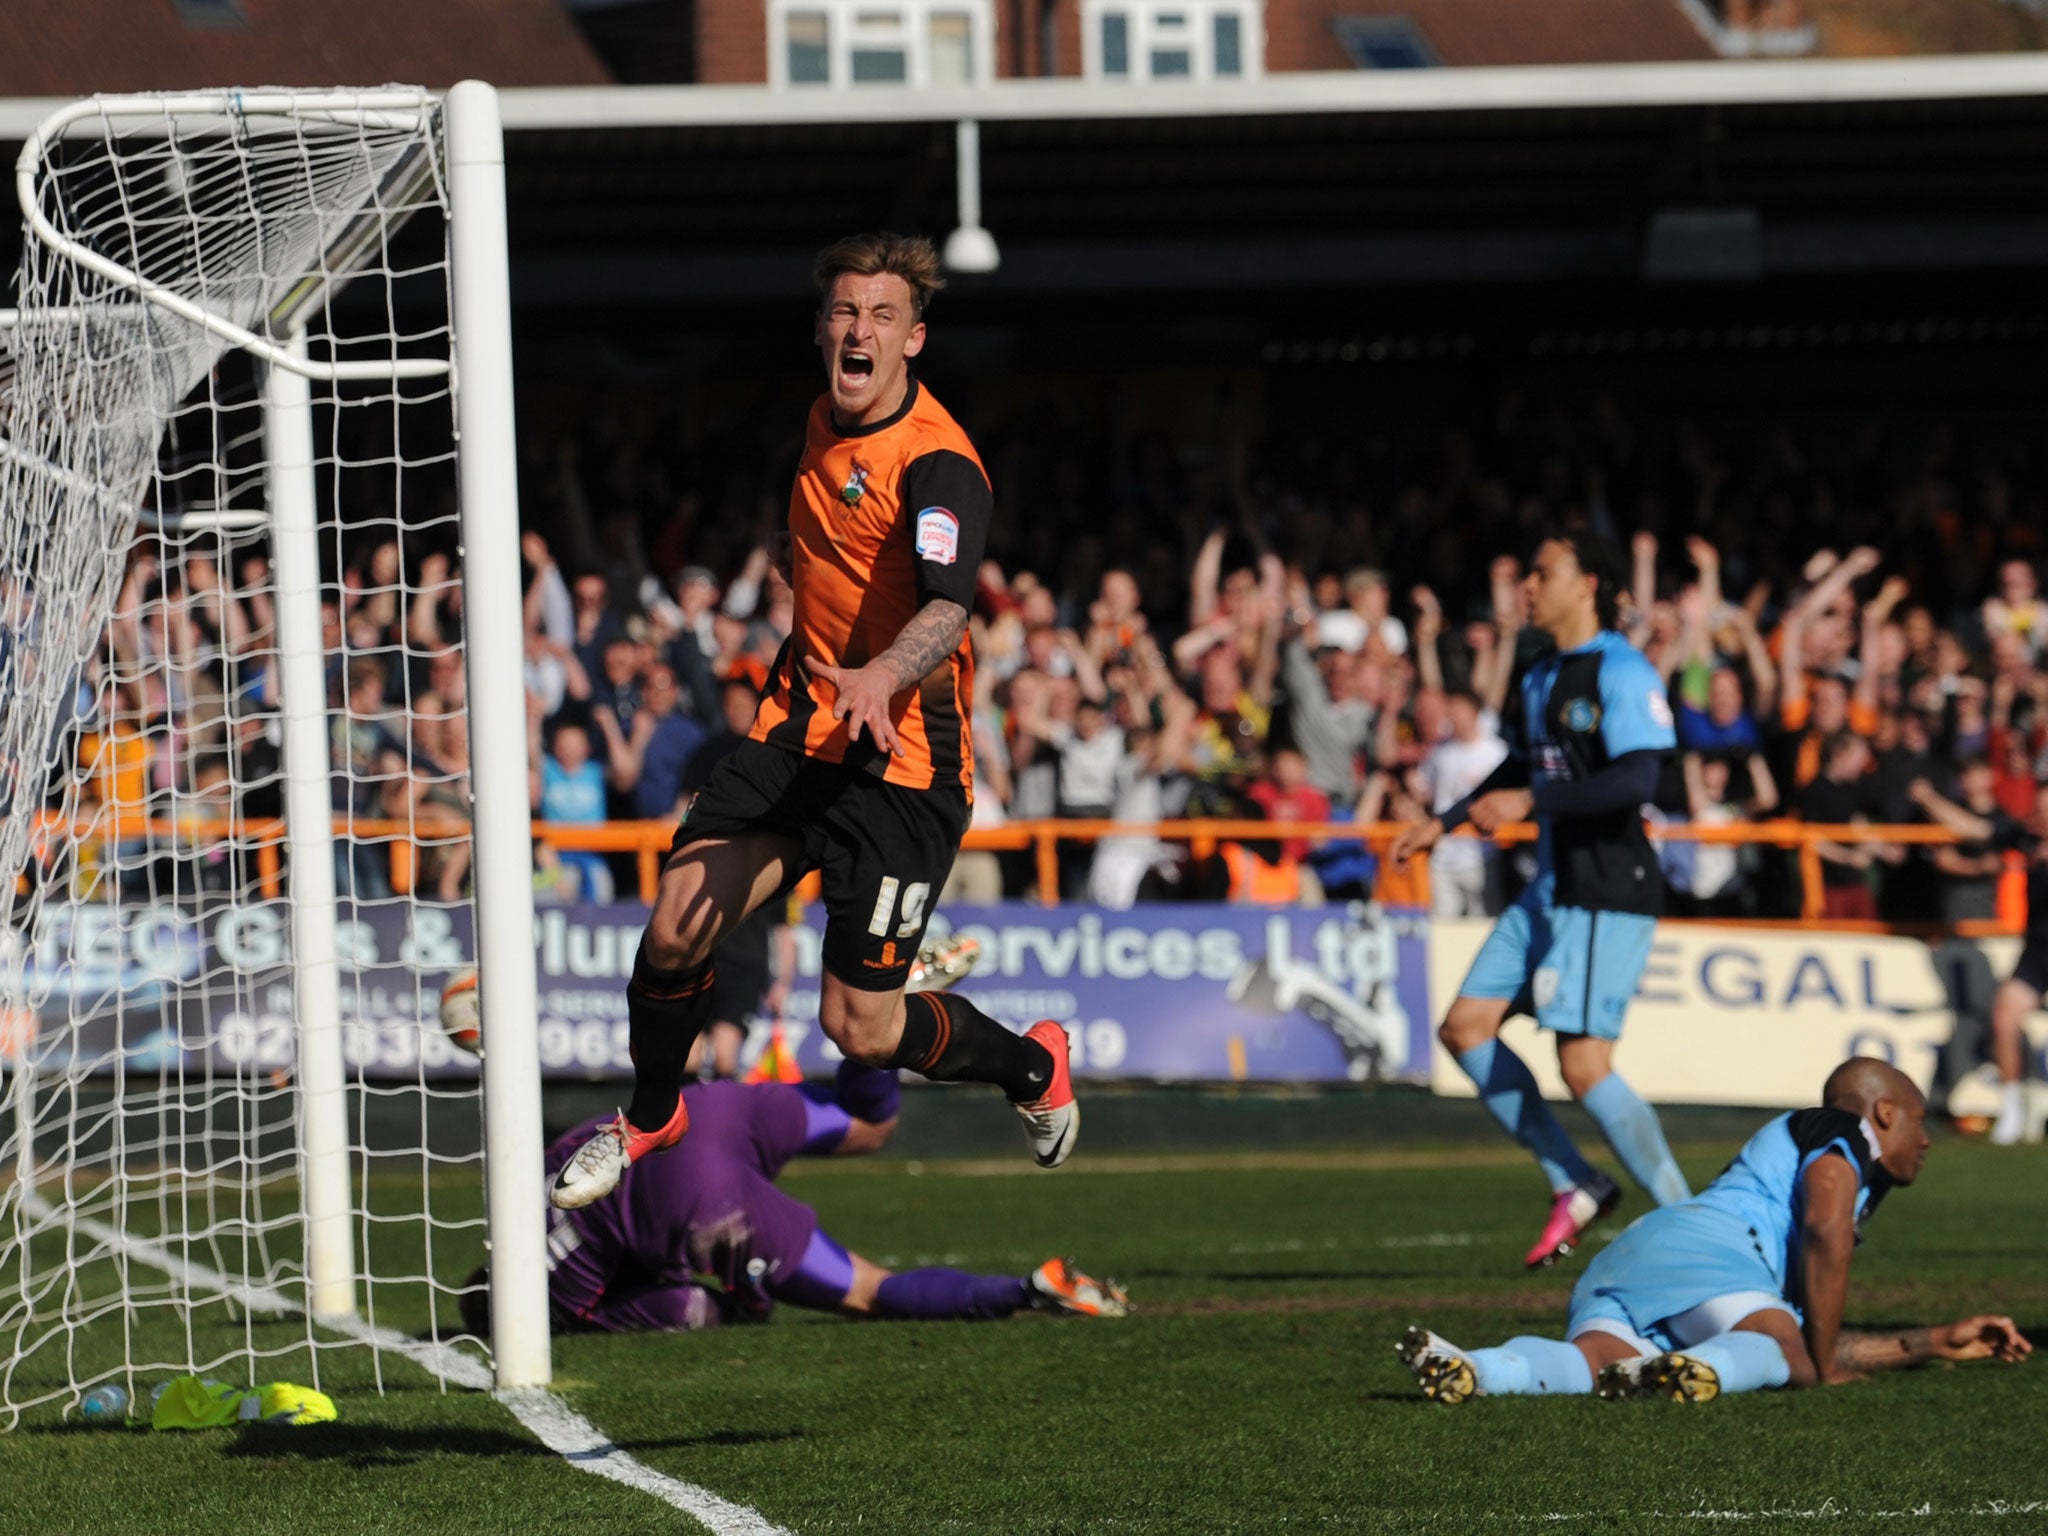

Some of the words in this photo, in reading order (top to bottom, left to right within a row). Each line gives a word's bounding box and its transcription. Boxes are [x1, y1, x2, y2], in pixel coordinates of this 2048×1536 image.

[868, 875, 931, 938] 19
[215, 904, 380, 973] Gs
[218, 1012, 296, 1066] 02
